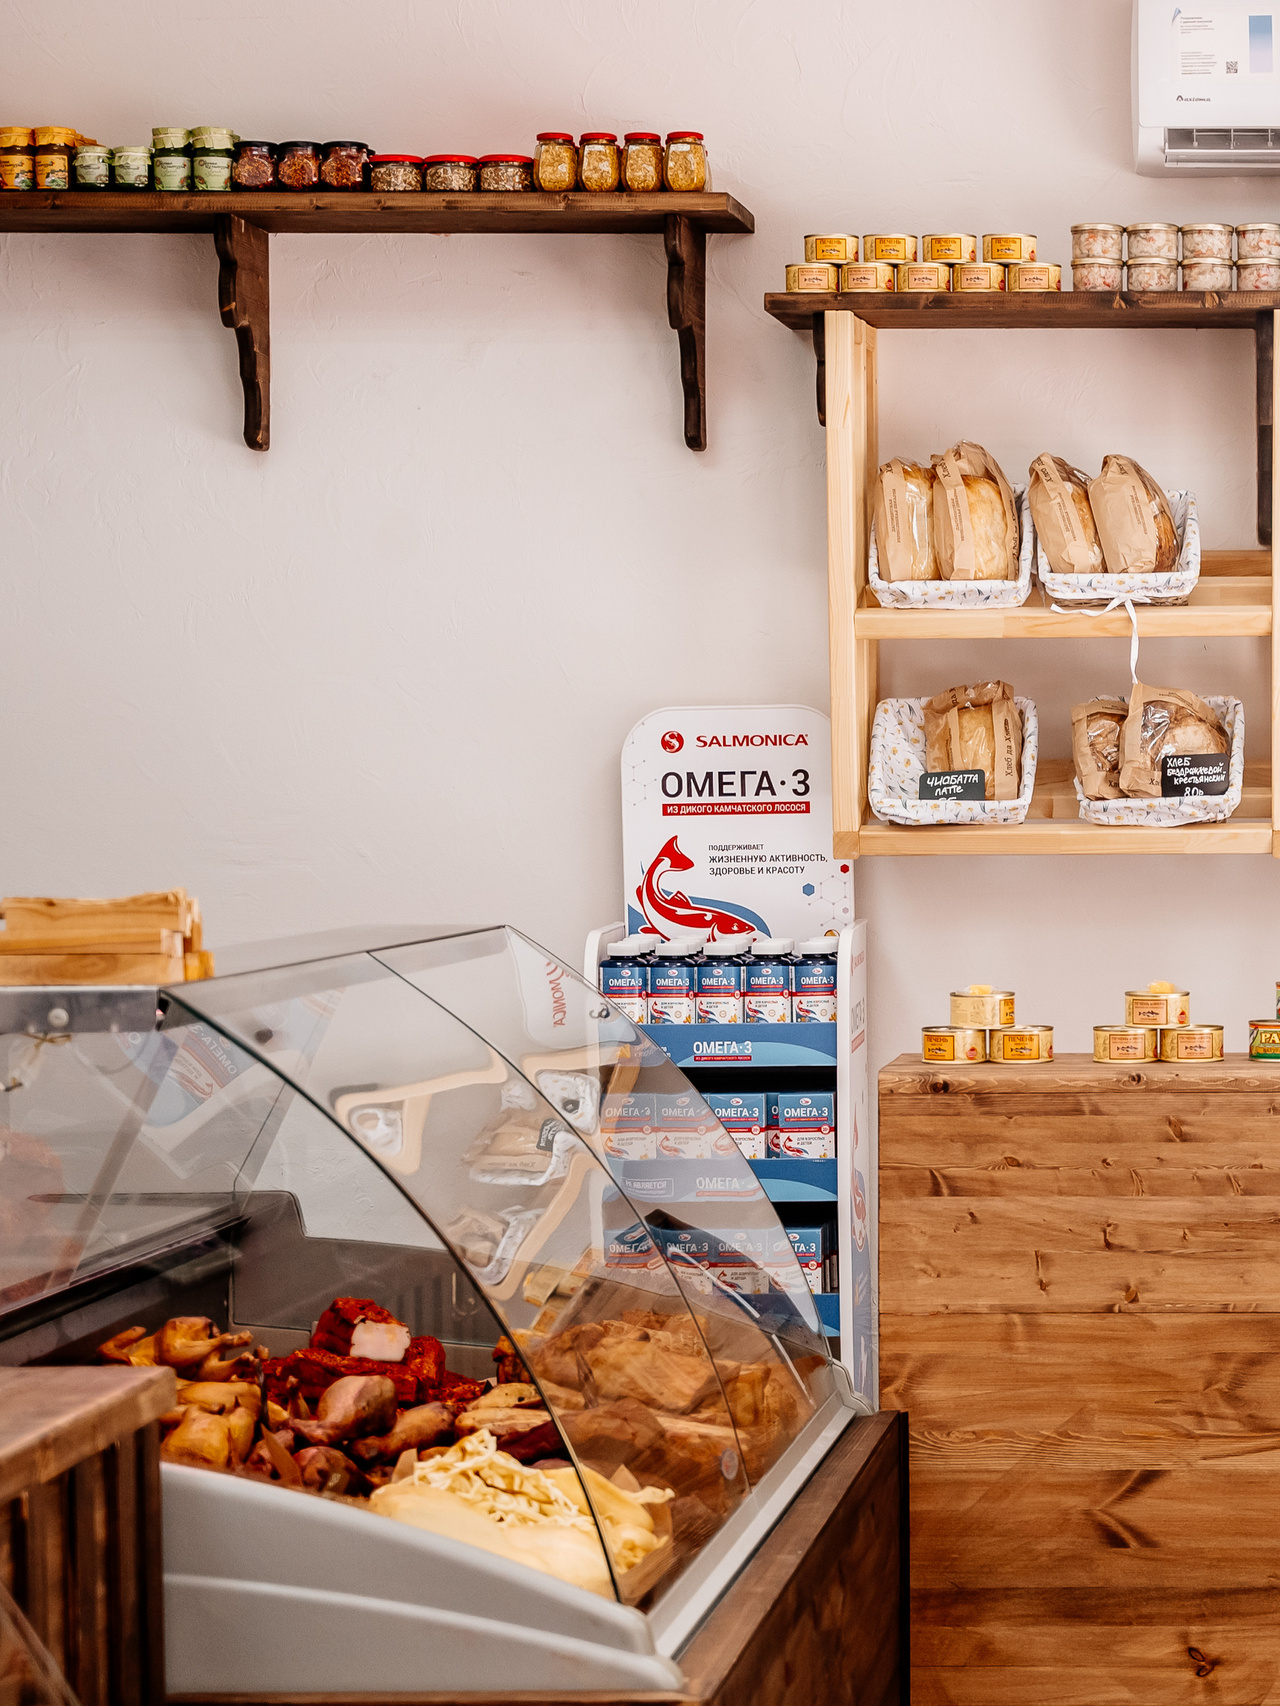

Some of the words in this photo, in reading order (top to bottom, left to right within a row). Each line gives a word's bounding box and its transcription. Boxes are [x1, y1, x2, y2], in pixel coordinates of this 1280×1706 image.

[695, 733, 809, 748] SALMONICA
[1006, 745, 1013, 756] да
[1005, 757, 1013, 777] Хлеб
[667, 806, 679, 814] ИЗ
[679, 805, 713, 815] ДИКОГО
[713, 803, 773, 813] КАМЧАТСКОГО
[773, 803, 806, 812] ЛОСОСЯ
[708, 843, 764, 852] ПОДДЕРЖИВАЕТ
[708, 854, 767, 864] ЖИЗНЕННУЮ
[768, 853, 828, 863] АКТИВНОСТЬ,
[709, 866, 756, 877] ЗДОРОВЬЕ
[757, 867, 764, 875] И
[765, 865, 806, 875] КРАСОТУ
